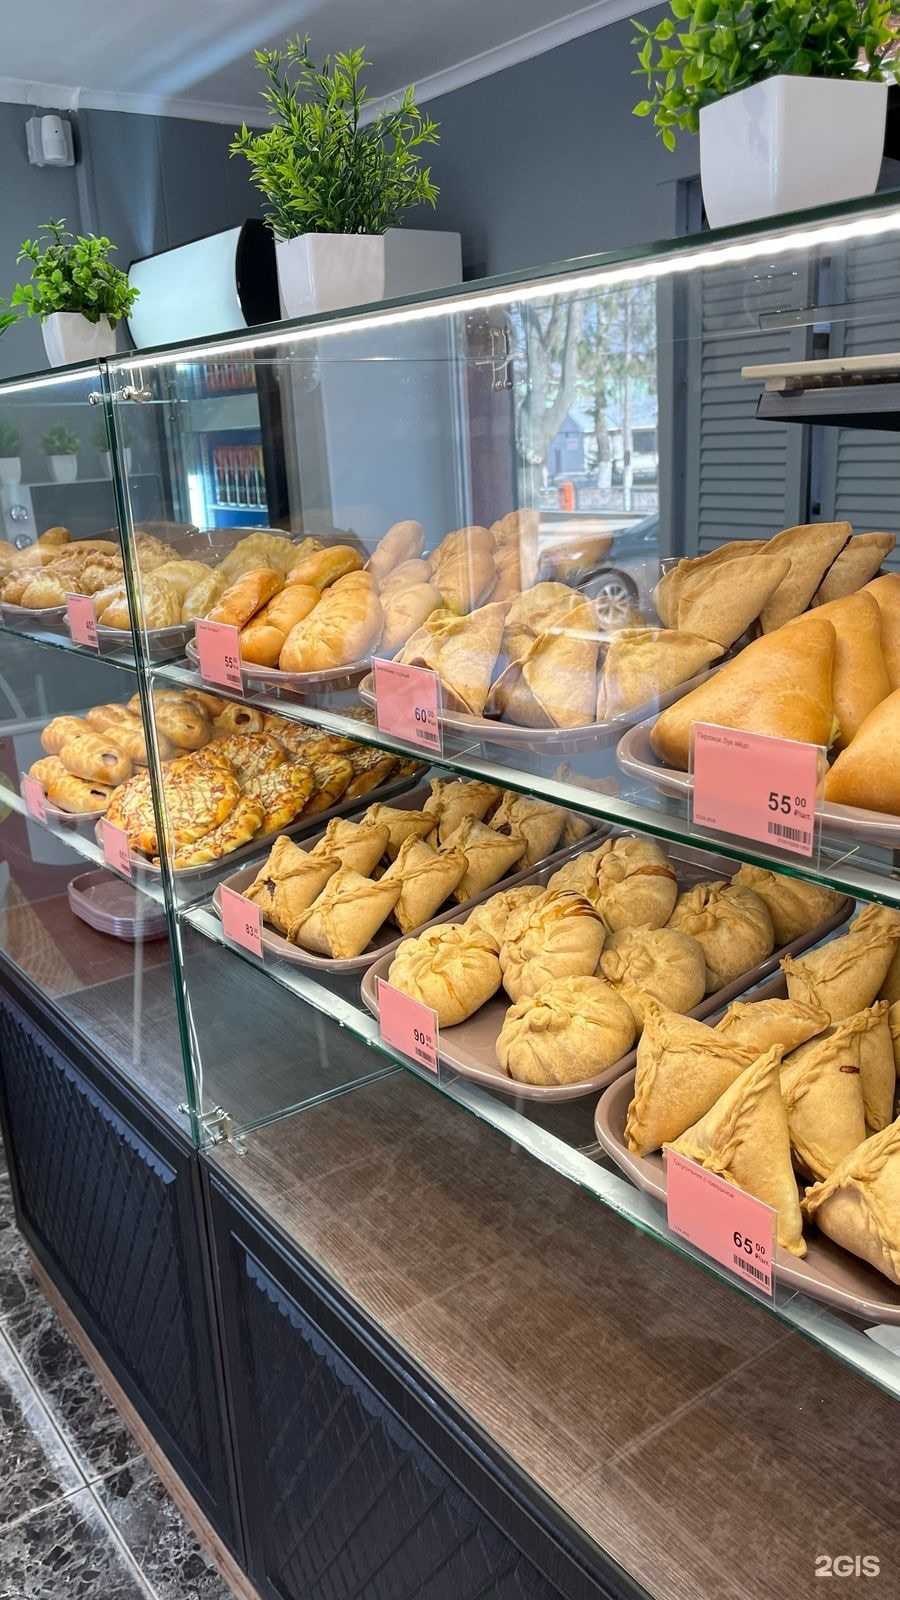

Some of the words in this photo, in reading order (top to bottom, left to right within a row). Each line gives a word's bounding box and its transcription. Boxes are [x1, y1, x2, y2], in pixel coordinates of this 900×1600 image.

[224, 655, 233, 669] 55
[415, 707, 427, 724] 60
[768, 791, 791, 815] 55
[794, 795, 807, 808] 00
[413, 1028, 425, 1045] 90
[733, 1231, 753, 1255] 65
[755, 1243, 766, 1255] 00
